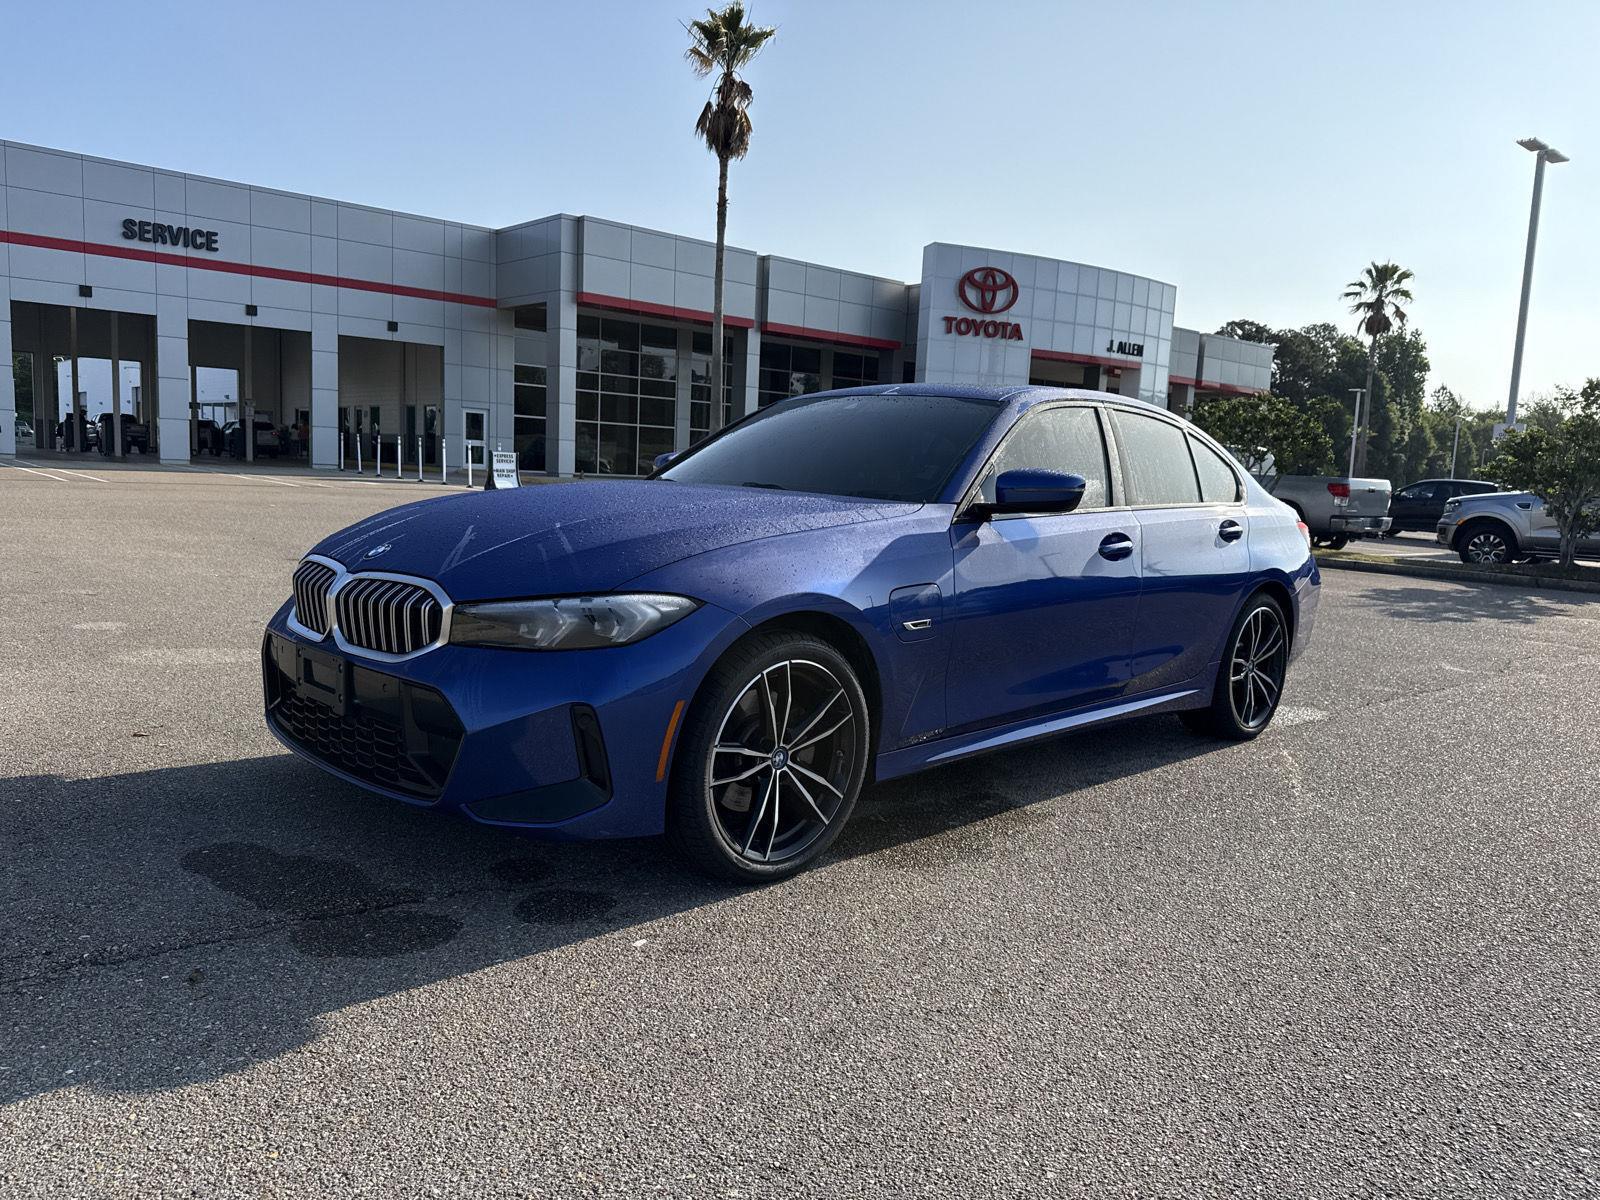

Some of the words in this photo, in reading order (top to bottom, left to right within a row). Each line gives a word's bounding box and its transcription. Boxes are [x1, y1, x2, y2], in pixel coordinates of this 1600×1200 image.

[122, 218, 219, 252] SERVICE
[943, 316, 1023, 341] TOYOTA
[1106, 339, 1115, 353] J.
[1116, 341, 1144, 357] ALLEN
